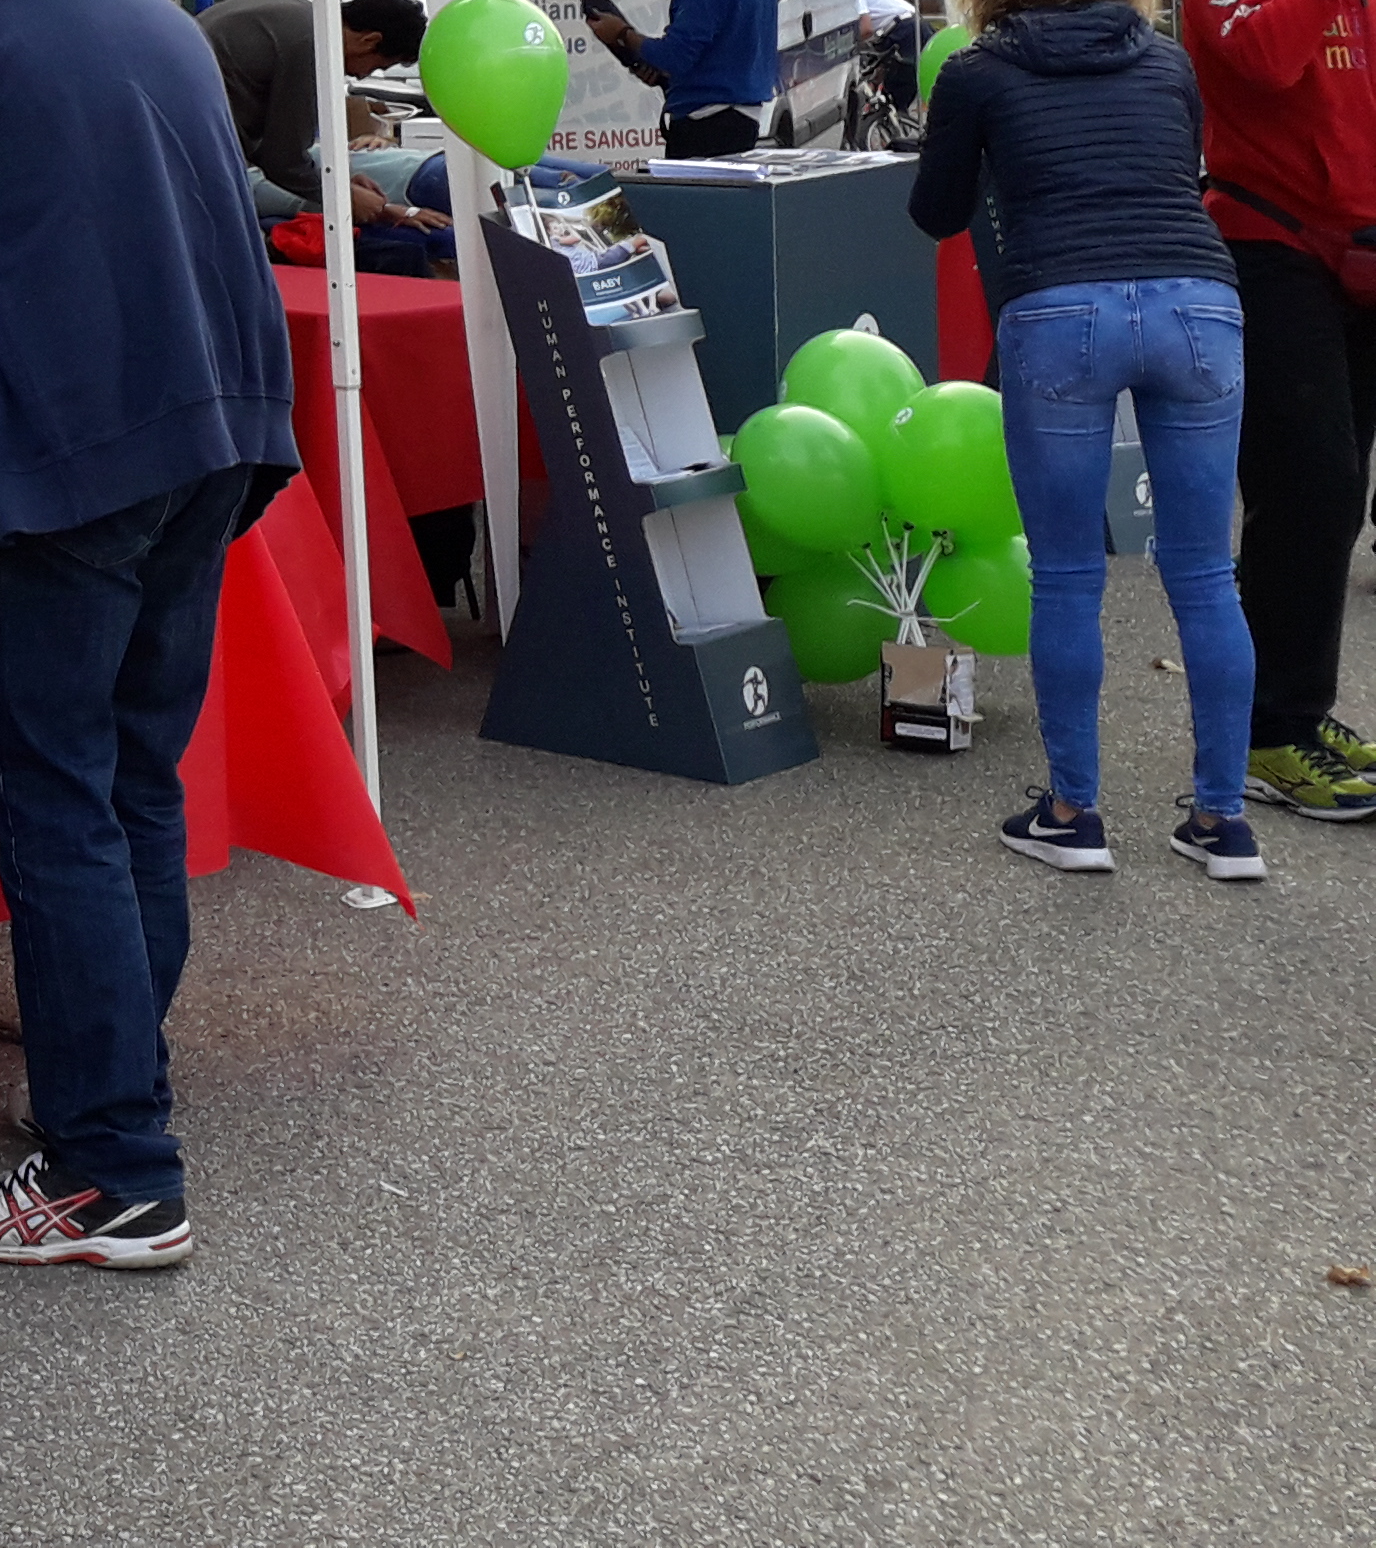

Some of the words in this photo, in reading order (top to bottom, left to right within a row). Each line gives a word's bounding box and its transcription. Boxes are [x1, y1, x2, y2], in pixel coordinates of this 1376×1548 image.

[585, 128, 666, 150] SANGUE
[537, 299, 567, 379] HUMAN
[562, 388, 617, 568] PERFORMANCE
[615, 578, 660, 728] INSTITUTE
